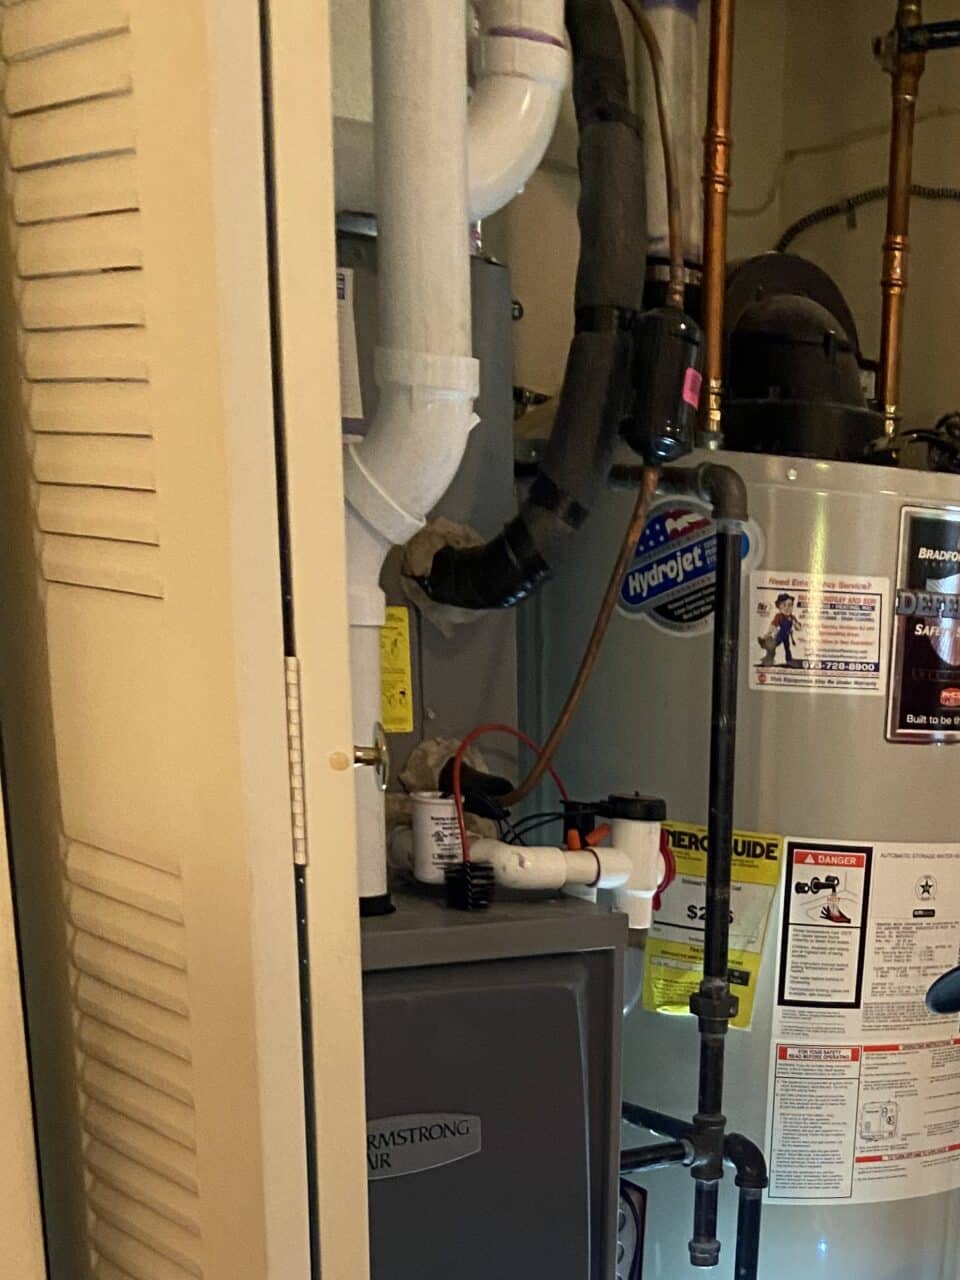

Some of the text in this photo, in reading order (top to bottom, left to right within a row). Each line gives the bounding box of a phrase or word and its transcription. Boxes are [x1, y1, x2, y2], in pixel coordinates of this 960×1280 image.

[628, 547, 703, 598] Hydrojet
[906, 713, 927, 724] Built
[929, 715, 939, 724] to
[940, 716, 952, 725] be
[817, 855, 857, 866] DANGER
[367, 1120, 470, 1150] RMSTRONG
